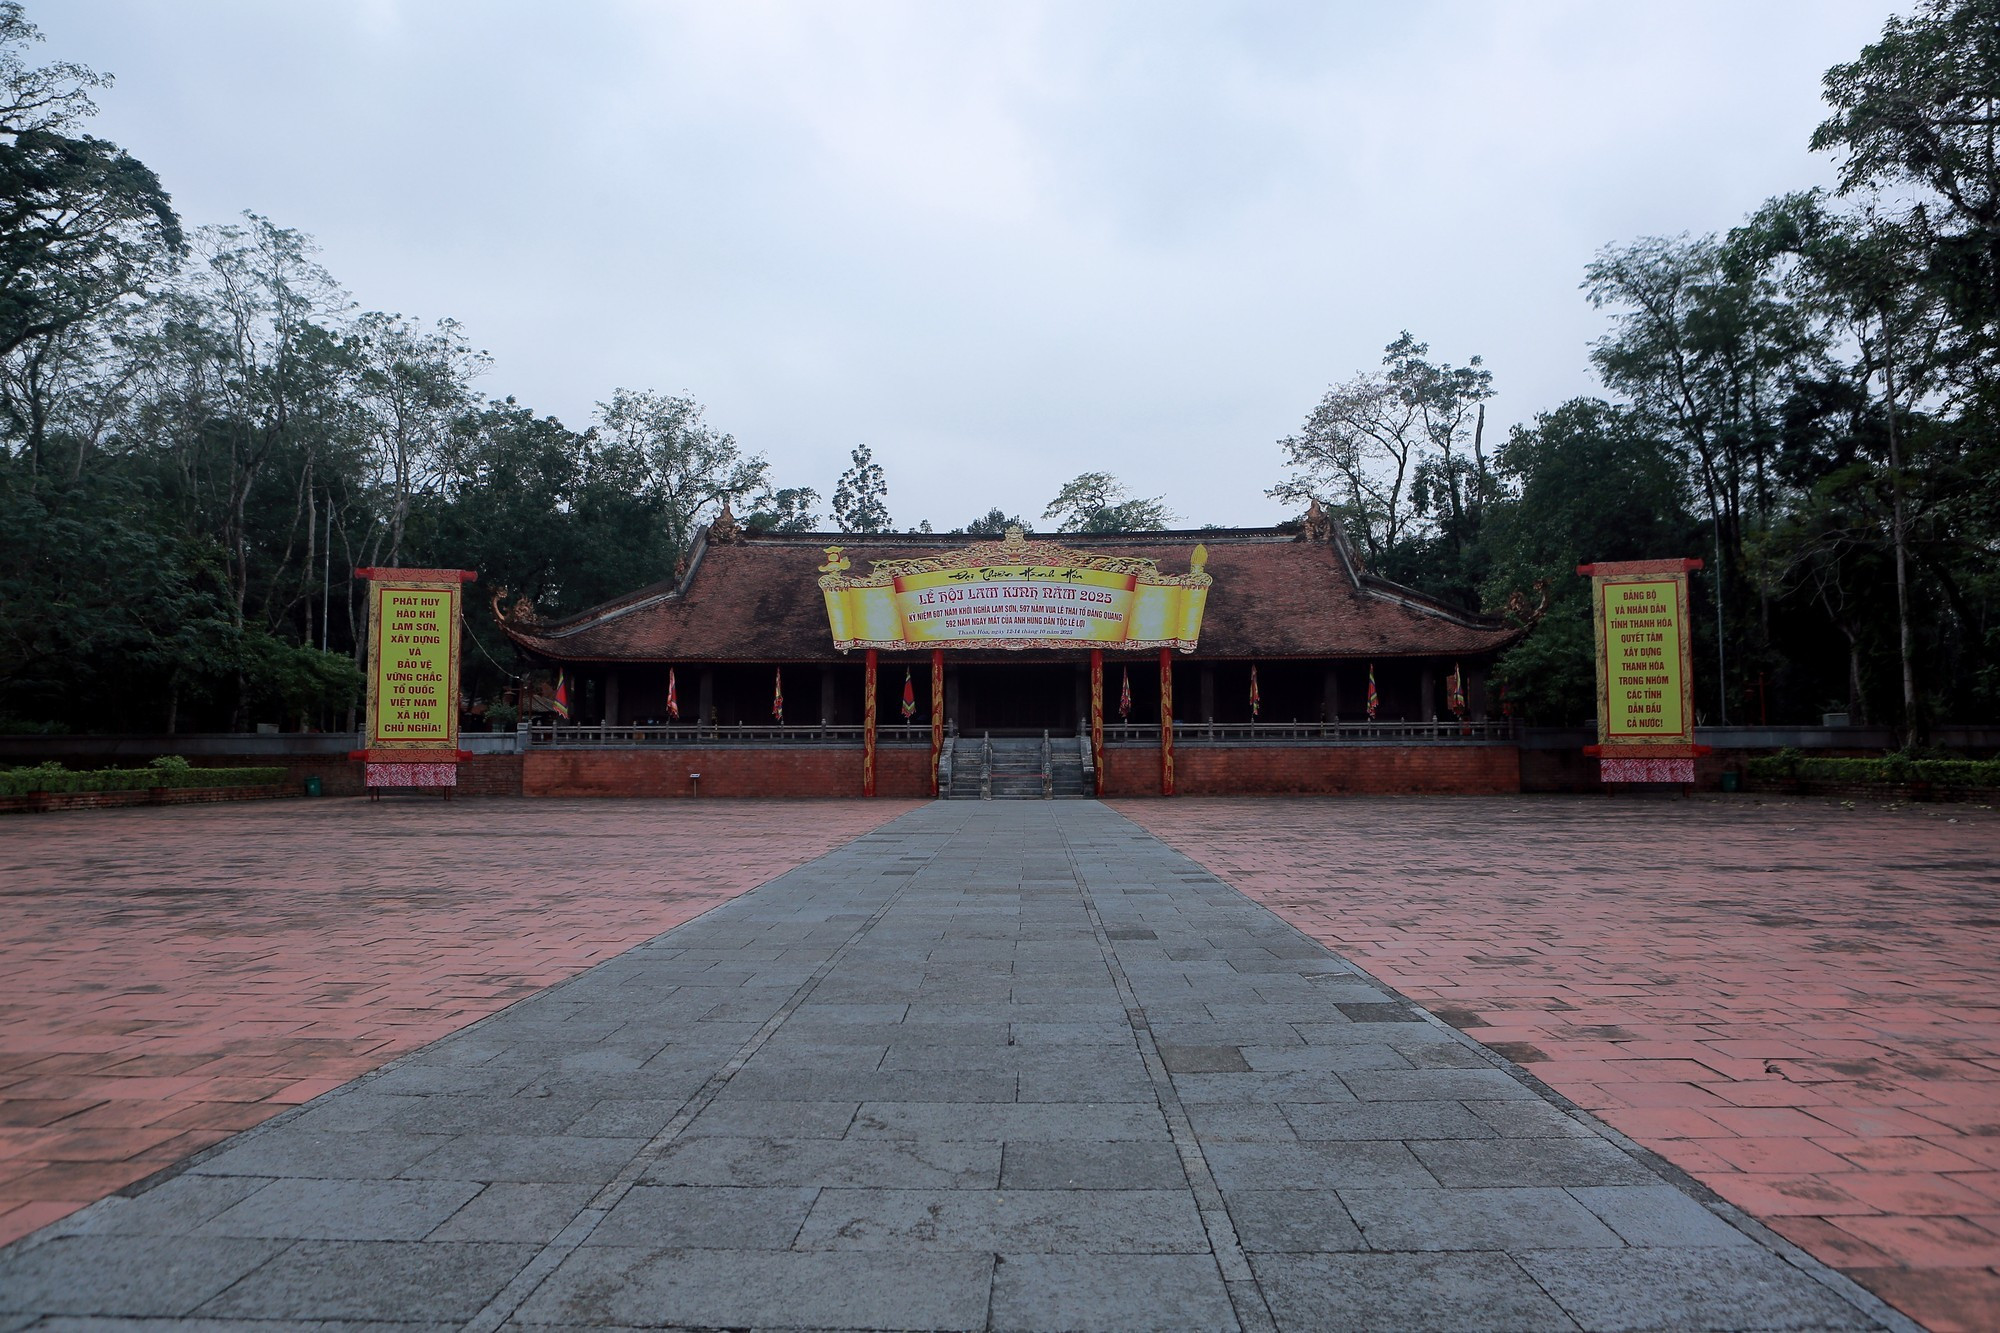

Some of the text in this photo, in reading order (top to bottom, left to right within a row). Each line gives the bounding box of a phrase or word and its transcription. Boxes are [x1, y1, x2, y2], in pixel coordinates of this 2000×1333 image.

[919, 586, 1112, 605] LỄ HỘI LAM KINH NĂM 2025
[1623, 589, 1657, 601] ĐẢNG BỘ
[393, 596, 440, 606] PHÁT HUY
[396, 609, 436, 618] HÀO KHÍ
[917, 611, 932, 621] NIỆM
[991, 605, 1003, 613] LAM
[1103, 612, 1122, 621] QUANG
[1615, 603, 1666, 615] VÀ NHÂN DÂN
[945, 620, 956, 628] 592
[1014, 616, 1025, 624] ANH
[1610, 617, 1672, 629] TỈNH THANH HÓA
[391, 634, 440, 645] XÂY DỰNG
[1621, 631, 1663, 643] QUYẾT TÂM
[409, 647, 421, 656] VÀ
[1624, 646, 1662, 658] XÂY DỰNG
[397, 659, 432, 670] BẢO VỆ
[1622, 660, 1665, 671] THANH HÓA
[386, 671, 442, 681] VỮNG CHẮC
[1618, 675, 1669, 685] TRONG NHÓM
[393, 683, 435, 694] TỔ QUỐC
[1627, 688, 1662, 699] CÁC TỈNH
[390, 697, 437, 708] VIỆT NAM
[1628, 702, 1644, 713] DẪN
[397, 710, 430, 721] XÃ HỘI
[384, 722, 441, 732] CHỦ NGHĨA!
[1627, 717, 1663, 728] CẢ NƯỚC!
